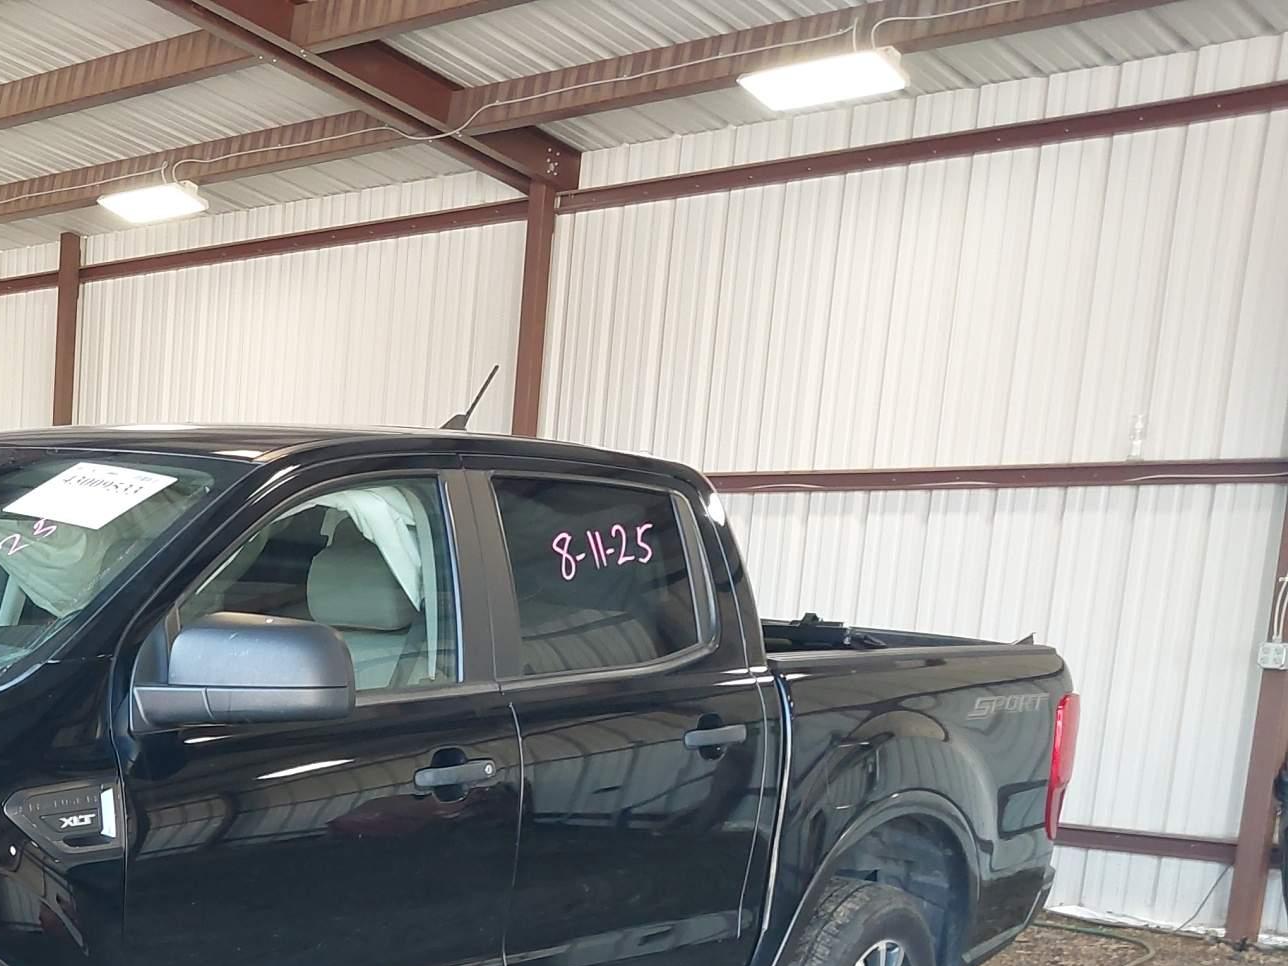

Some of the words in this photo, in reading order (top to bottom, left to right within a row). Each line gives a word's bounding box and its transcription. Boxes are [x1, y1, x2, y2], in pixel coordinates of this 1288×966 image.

[551, 523, 653, 580] 8-11-25
[966, 692, 1050, 720] SPORT
[58, 813, 96, 829] XLT
